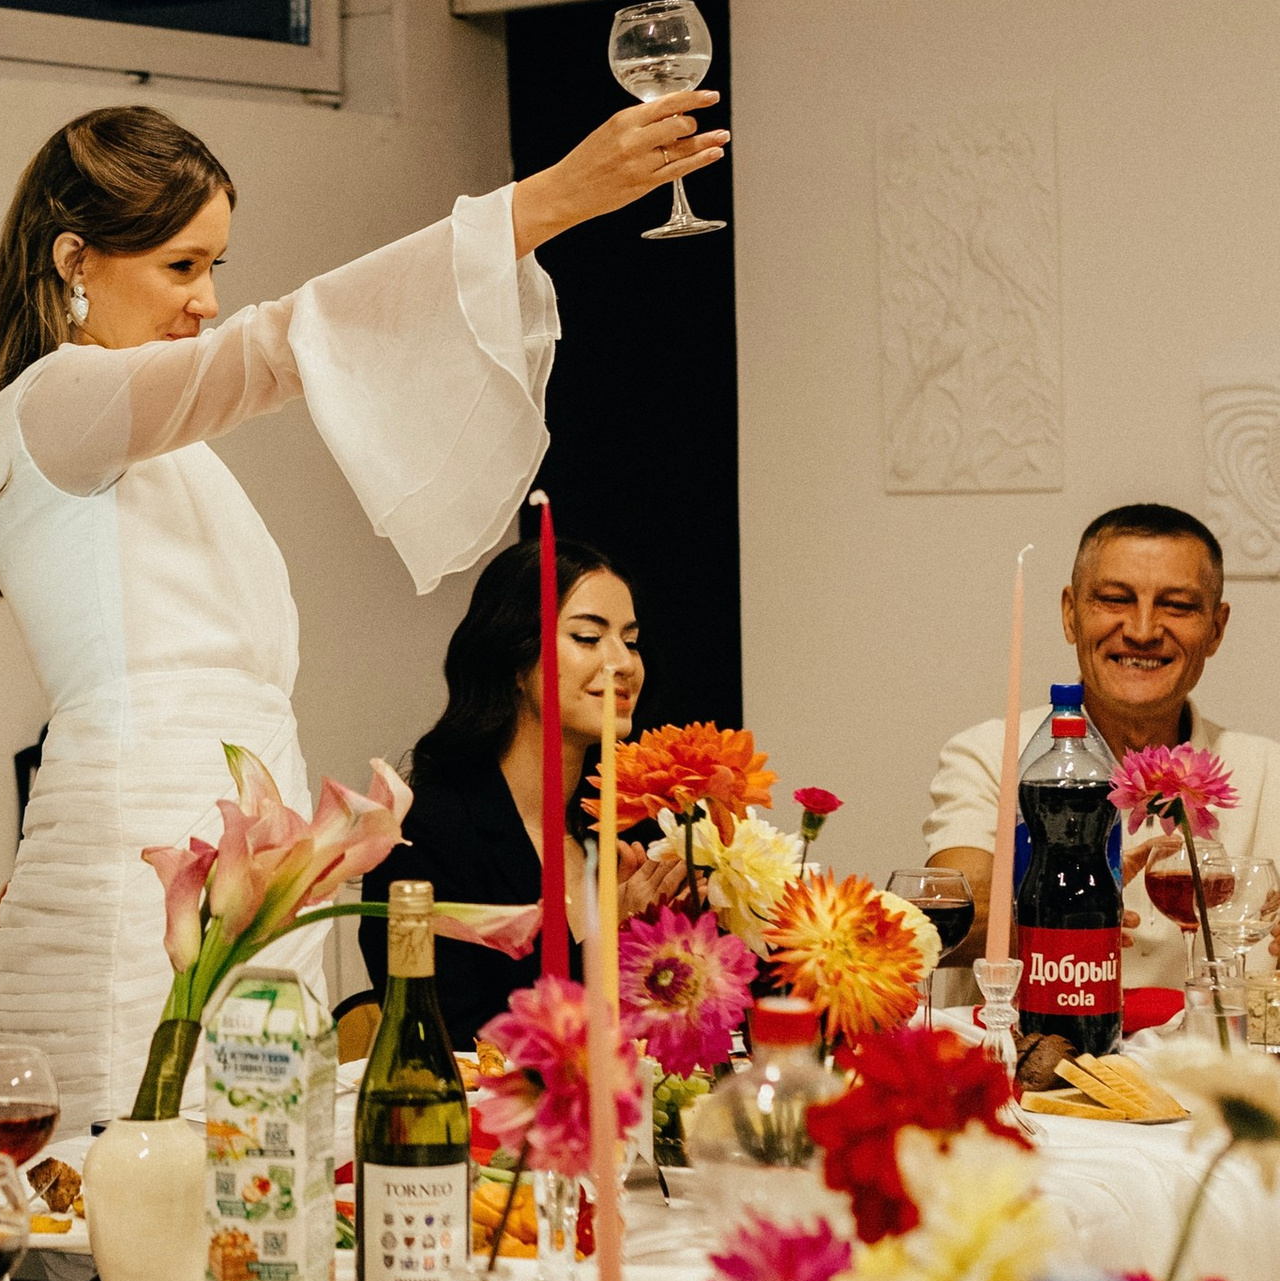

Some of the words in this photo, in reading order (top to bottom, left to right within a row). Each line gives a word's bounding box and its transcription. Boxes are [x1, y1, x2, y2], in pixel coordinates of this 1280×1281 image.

[1029, 952, 1117, 988] Добрый
[1056, 989, 1095, 1007] cola
[383, 1182, 454, 1198] TORNEO
